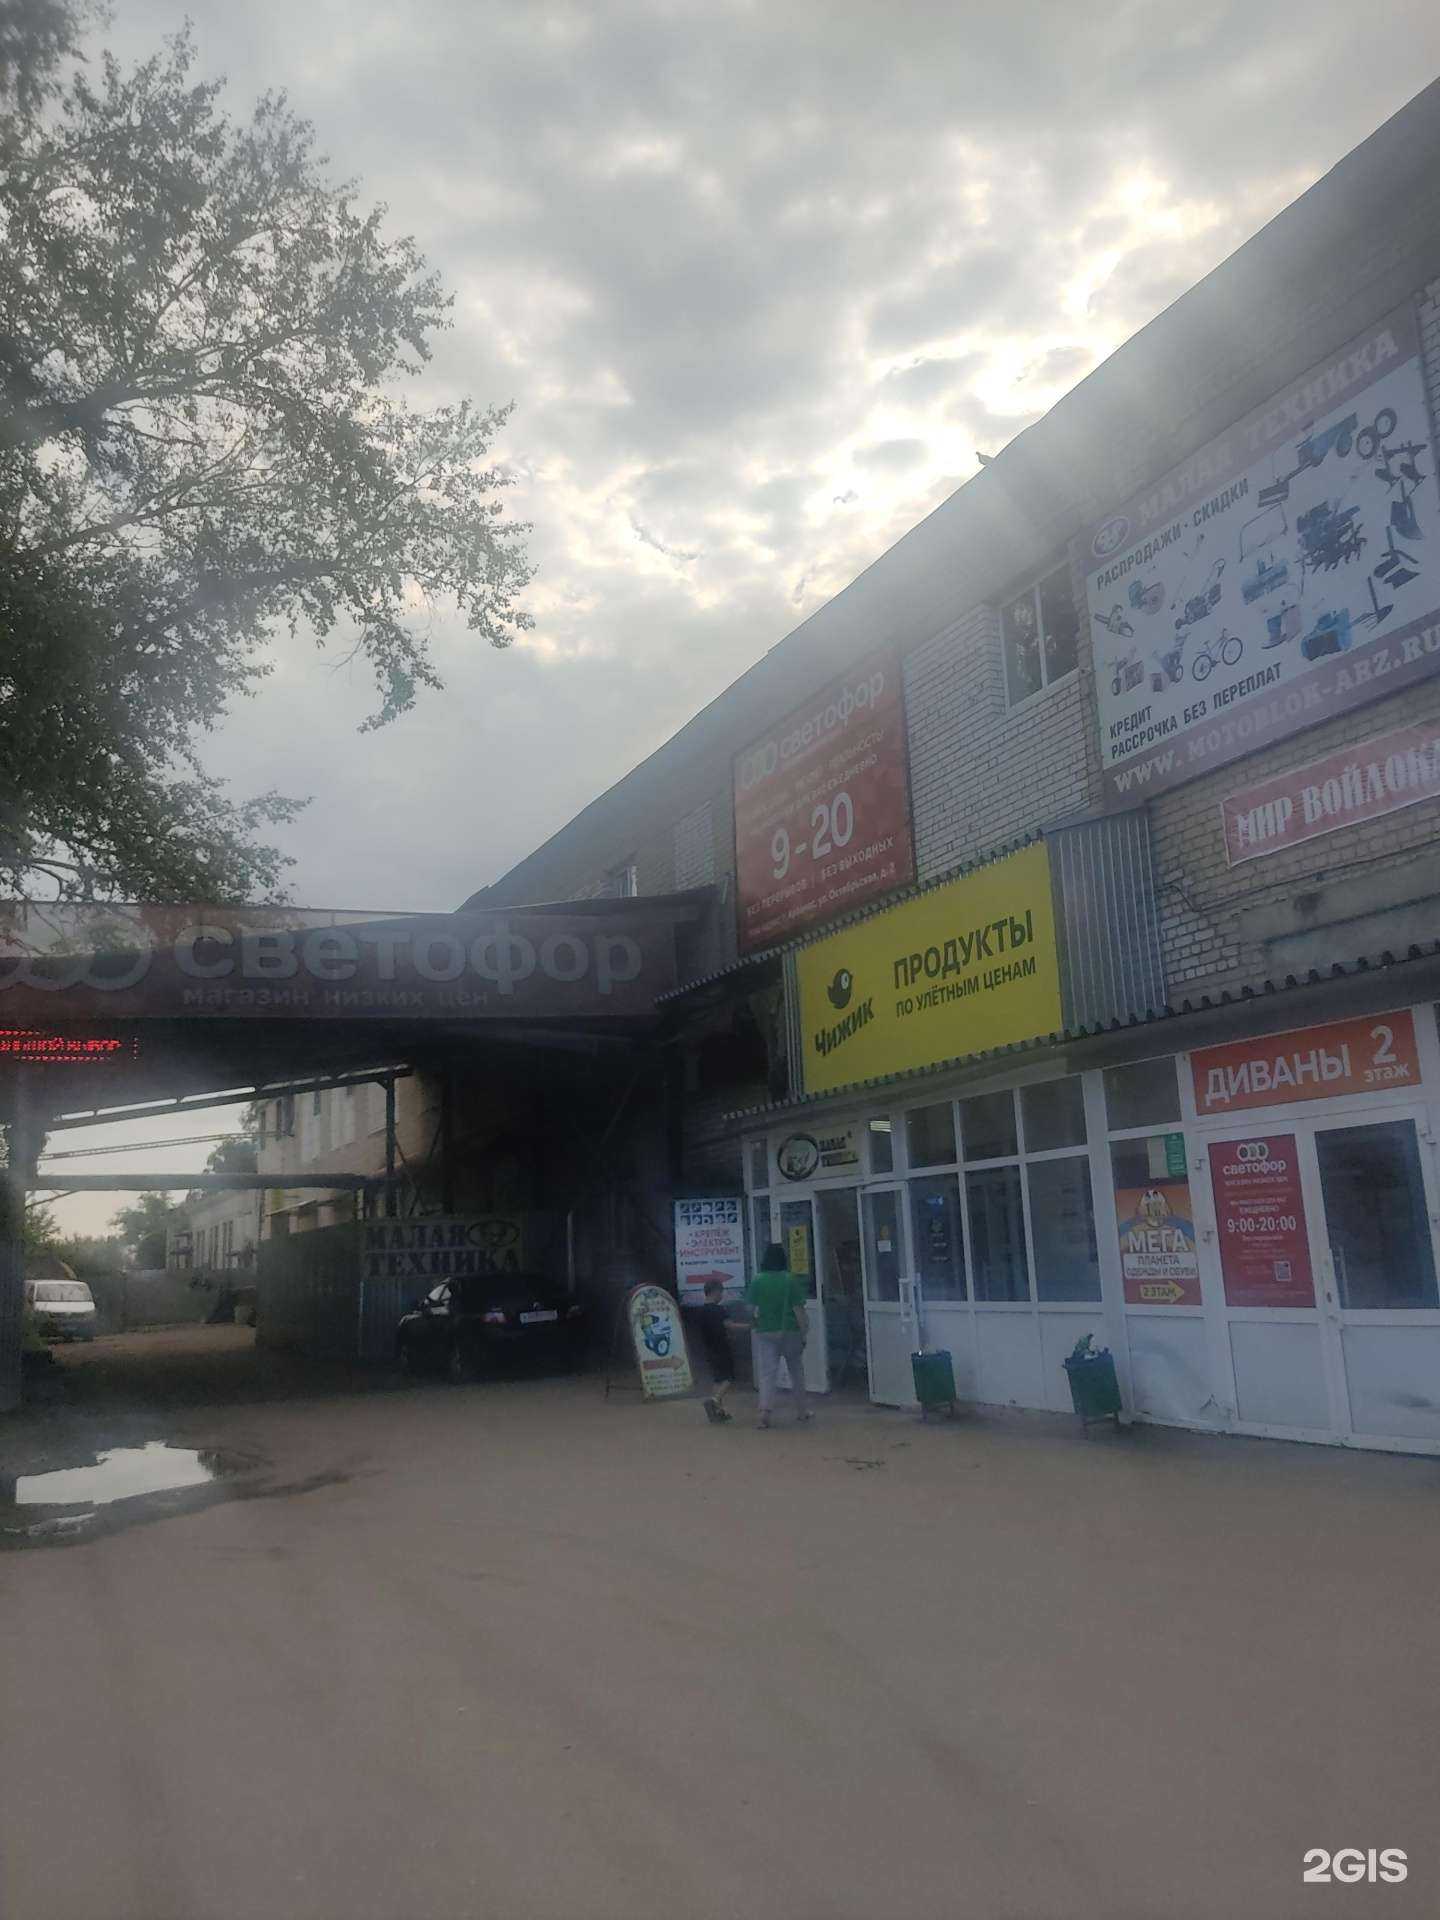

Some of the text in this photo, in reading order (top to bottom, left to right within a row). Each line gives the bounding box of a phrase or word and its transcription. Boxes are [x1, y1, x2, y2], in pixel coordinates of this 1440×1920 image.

[1244, 330, 1399, 452] ТЕХНИКА
[1096, 524, 1183, 592] РАСПРОДАЖИ
[1193, 478, 1249, 526] СКИДКИ
[779, 671, 885, 759] светофор
[1109, 706, 1153, 739] КРЕДИТ
[1111, 662, 1283, 759] РАССРОЧКА БЕЗ ПЕРЕПЛАТ
[1236, 797, 1293, 849] МИР
[840, 837, 894, 875] ВЫХОДНЫХ
[174, 920, 643, 994] светофор
[893, 910, 1034, 989] ПРОДУКТЫ
[183, 988, 310, 1007] магазин
[324, 988, 425, 1007] низких
[896, 956, 1037, 1018] ПО УЛЁТНЫМ ЦЕНАМ
[814, 997, 875, 1056] ЧИЖИК
[1370, 1025, 1397, 1065] 2
[1205, 1044, 1411, 1106] ДИВАНЫ этаж
[1222, 1159, 1287, 1175] светофор
[1128, 1229, 1189, 1253] МЕГА
[1227, 1215, 1296, 1233] 9:00-20:00
[1137, 1255, 1180, 1265] ПЛАНЕТА
